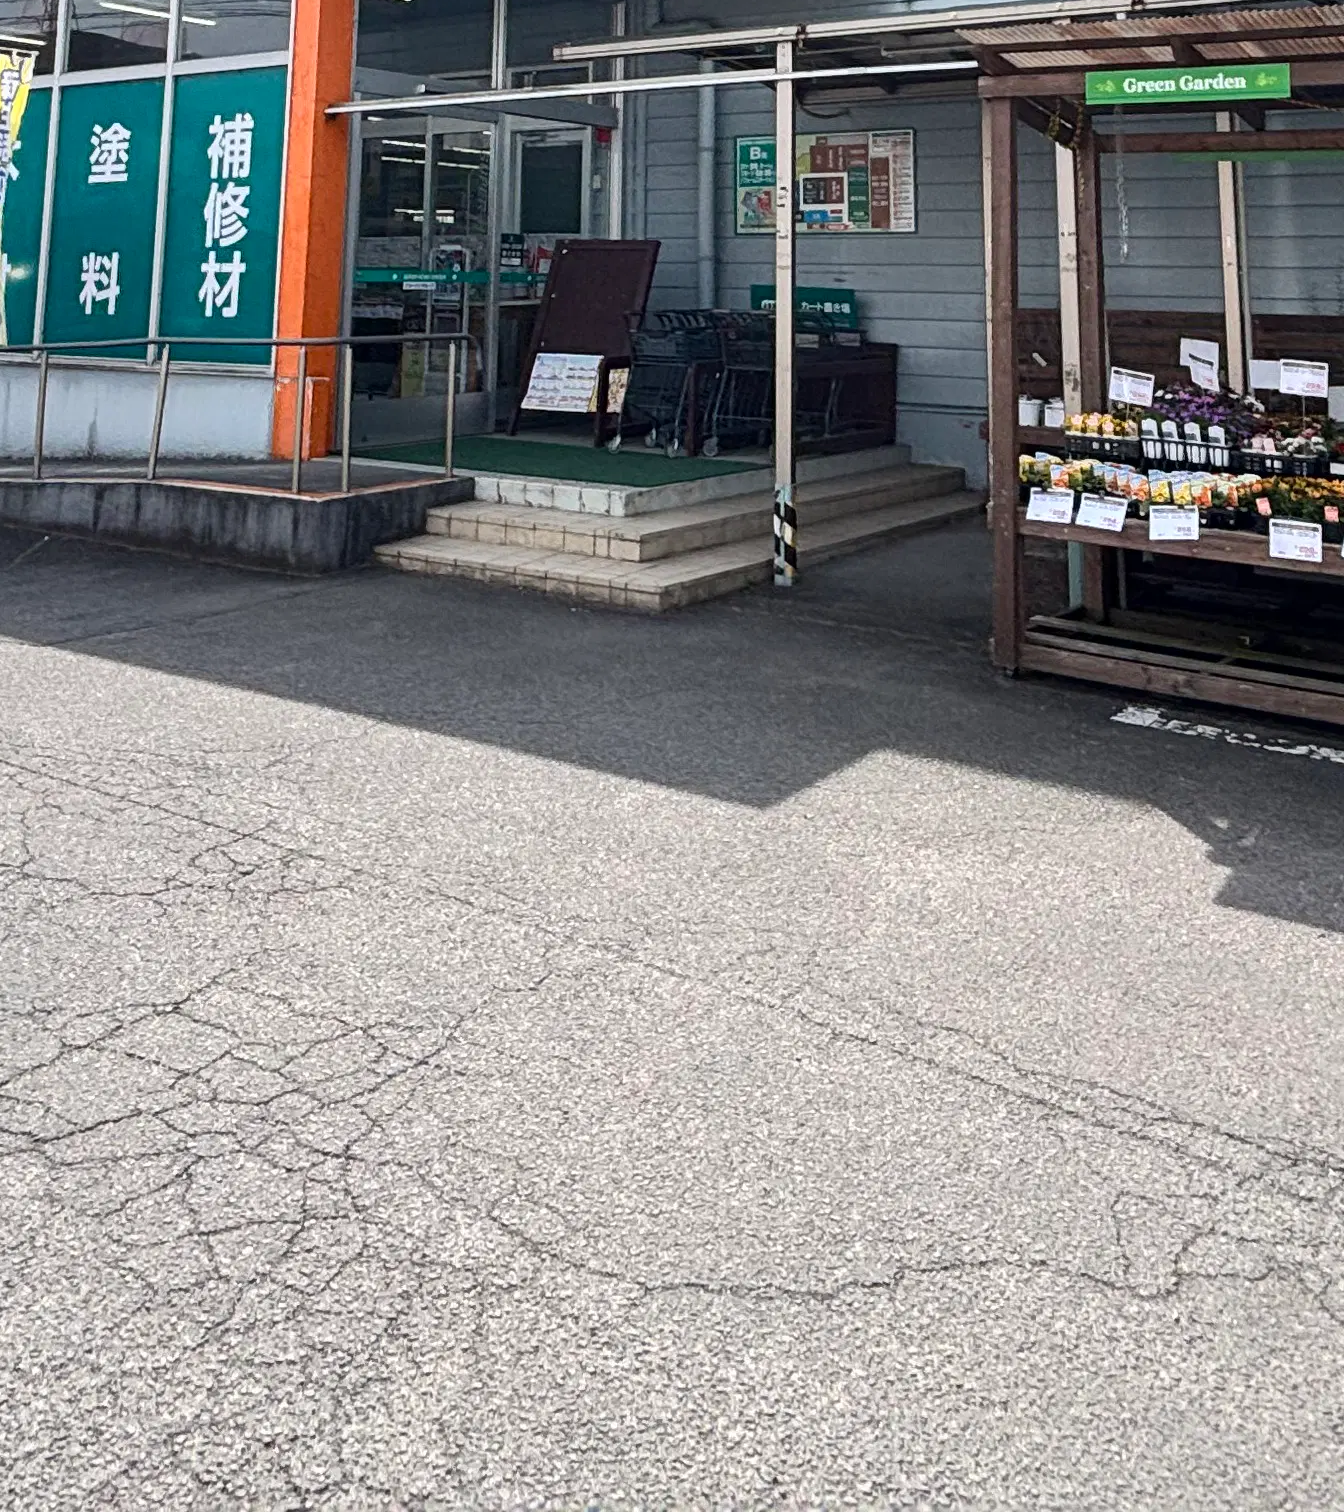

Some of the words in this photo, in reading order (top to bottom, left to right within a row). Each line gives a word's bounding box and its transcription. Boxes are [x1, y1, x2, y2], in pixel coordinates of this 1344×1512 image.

[1123, 77, 1176, 93] Green
[1179, 73, 1246, 91] Garden
[79, 122, 132, 315] 塗料
[198, 113, 255, 318] 補修材
